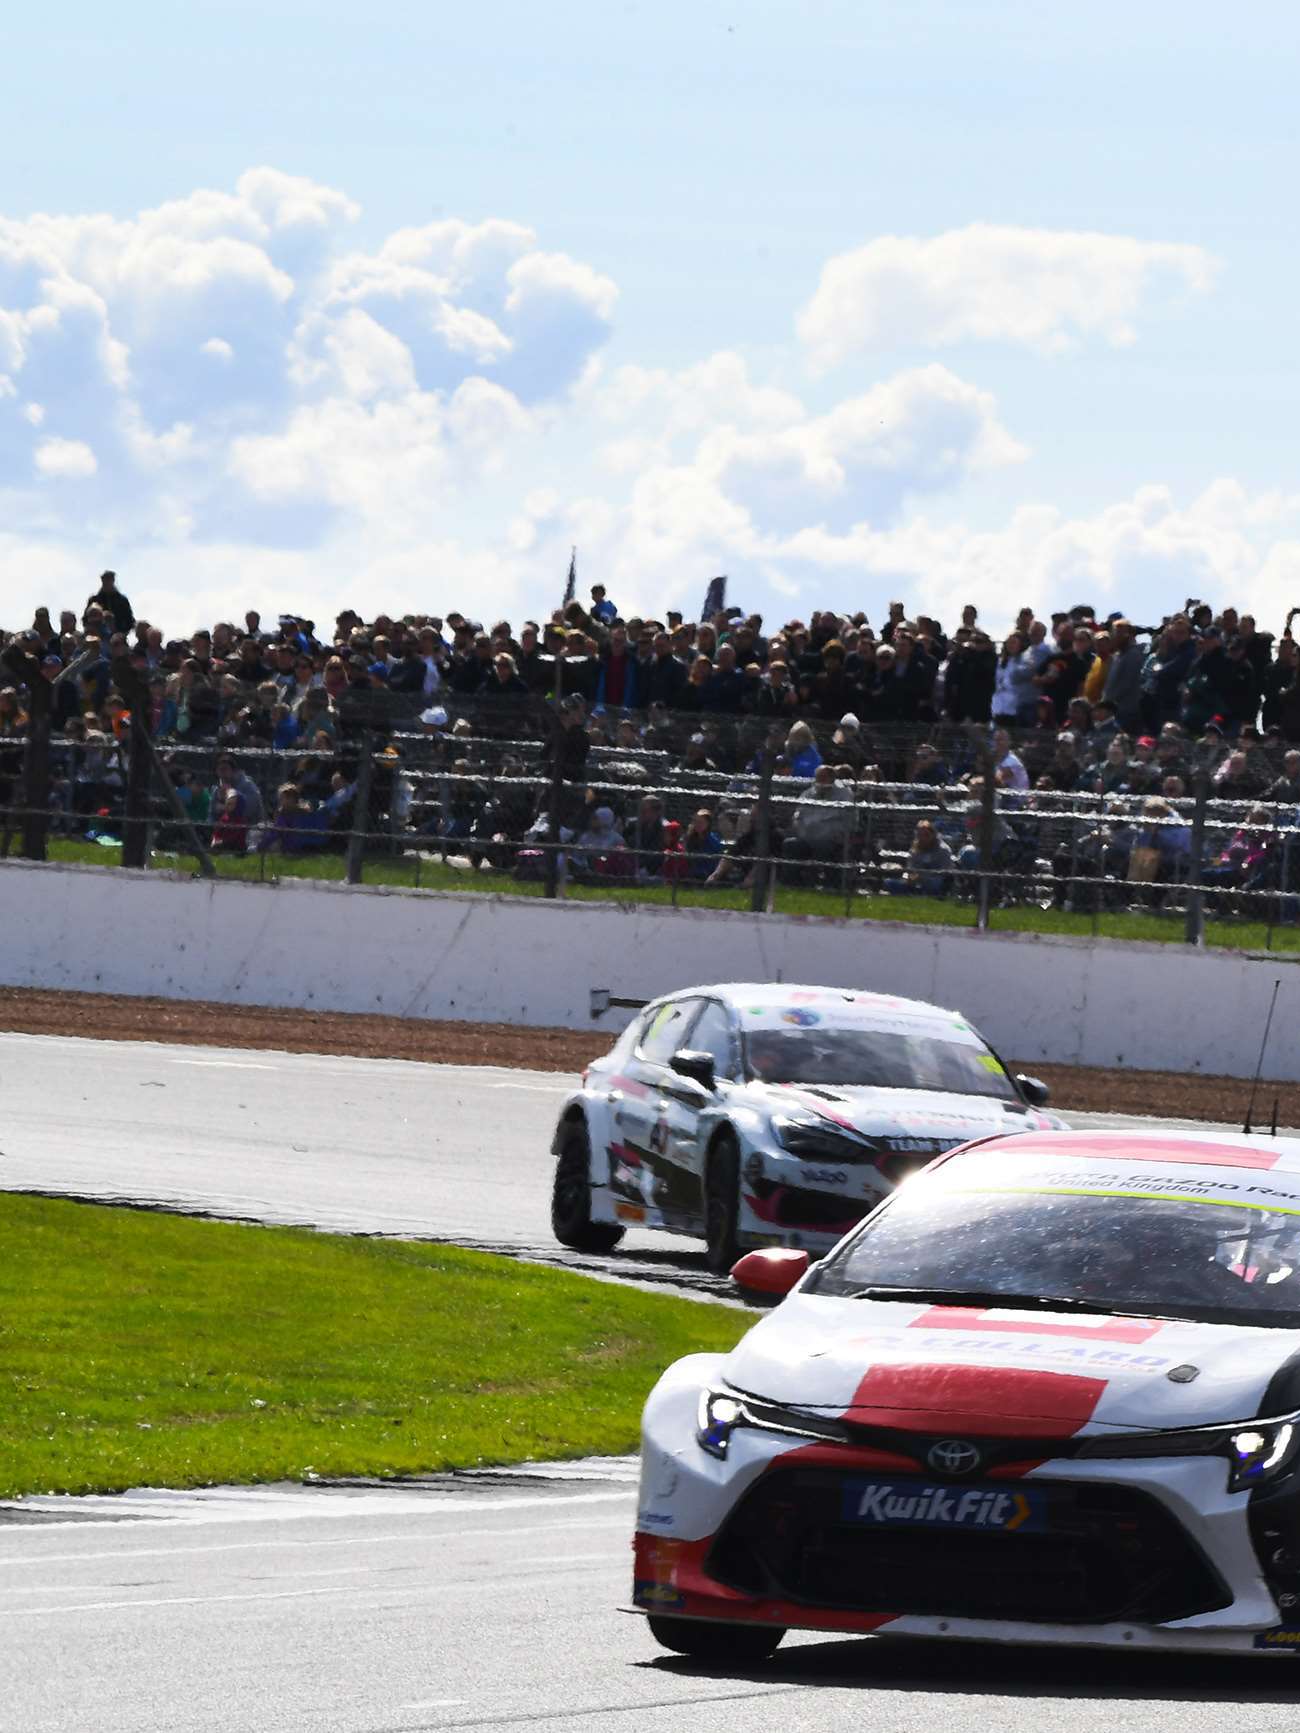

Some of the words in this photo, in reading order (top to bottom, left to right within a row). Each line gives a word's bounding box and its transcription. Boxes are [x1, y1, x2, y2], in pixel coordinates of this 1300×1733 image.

[1049, 1177, 1114, 1188] United
[1119, 1180, 1211, 1195] Kingdom
[1129, 1173, 1240, 1192] GAZOO
